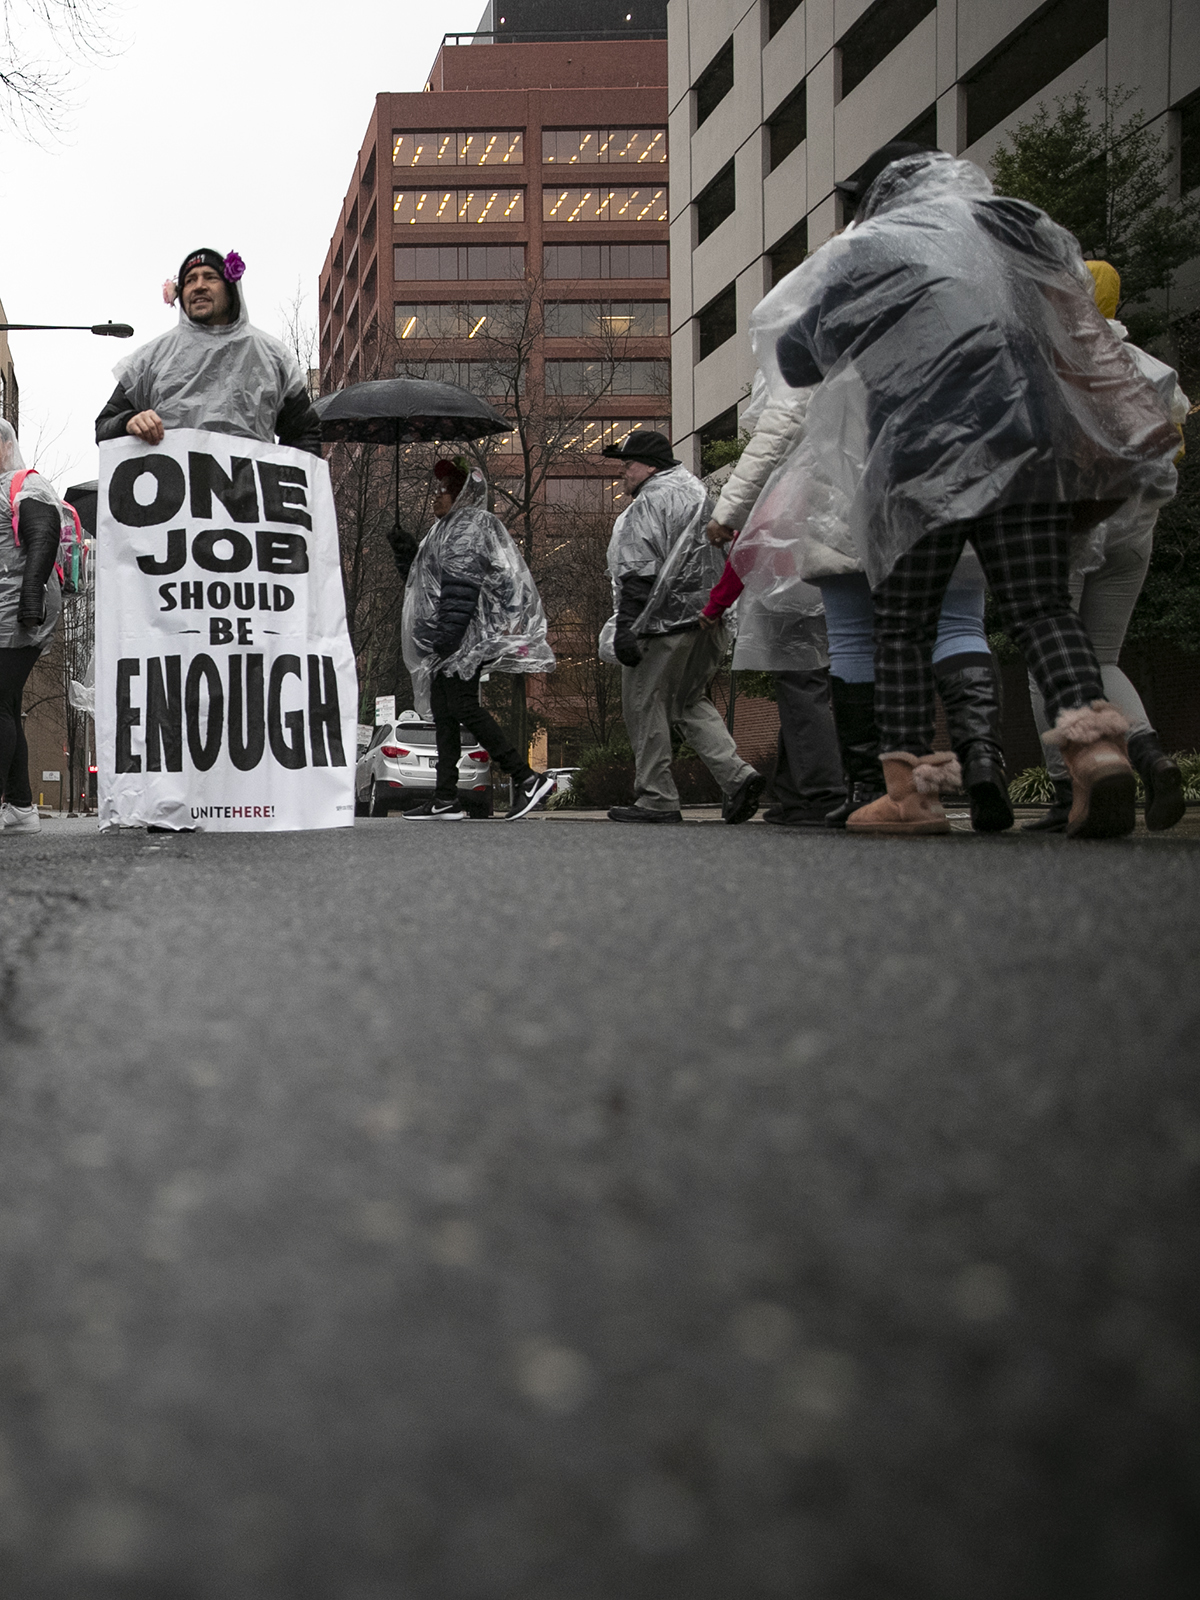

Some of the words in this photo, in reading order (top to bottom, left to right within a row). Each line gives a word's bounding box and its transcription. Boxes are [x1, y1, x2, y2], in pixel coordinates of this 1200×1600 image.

[108, 451, 313, 532] ONE
[136, 528, 310, 576] JOB
[158, 580, 295, 612] SHOULD
[209, 617, 254, 646] BE
[114, 652, 348, 775] ENOUGH
